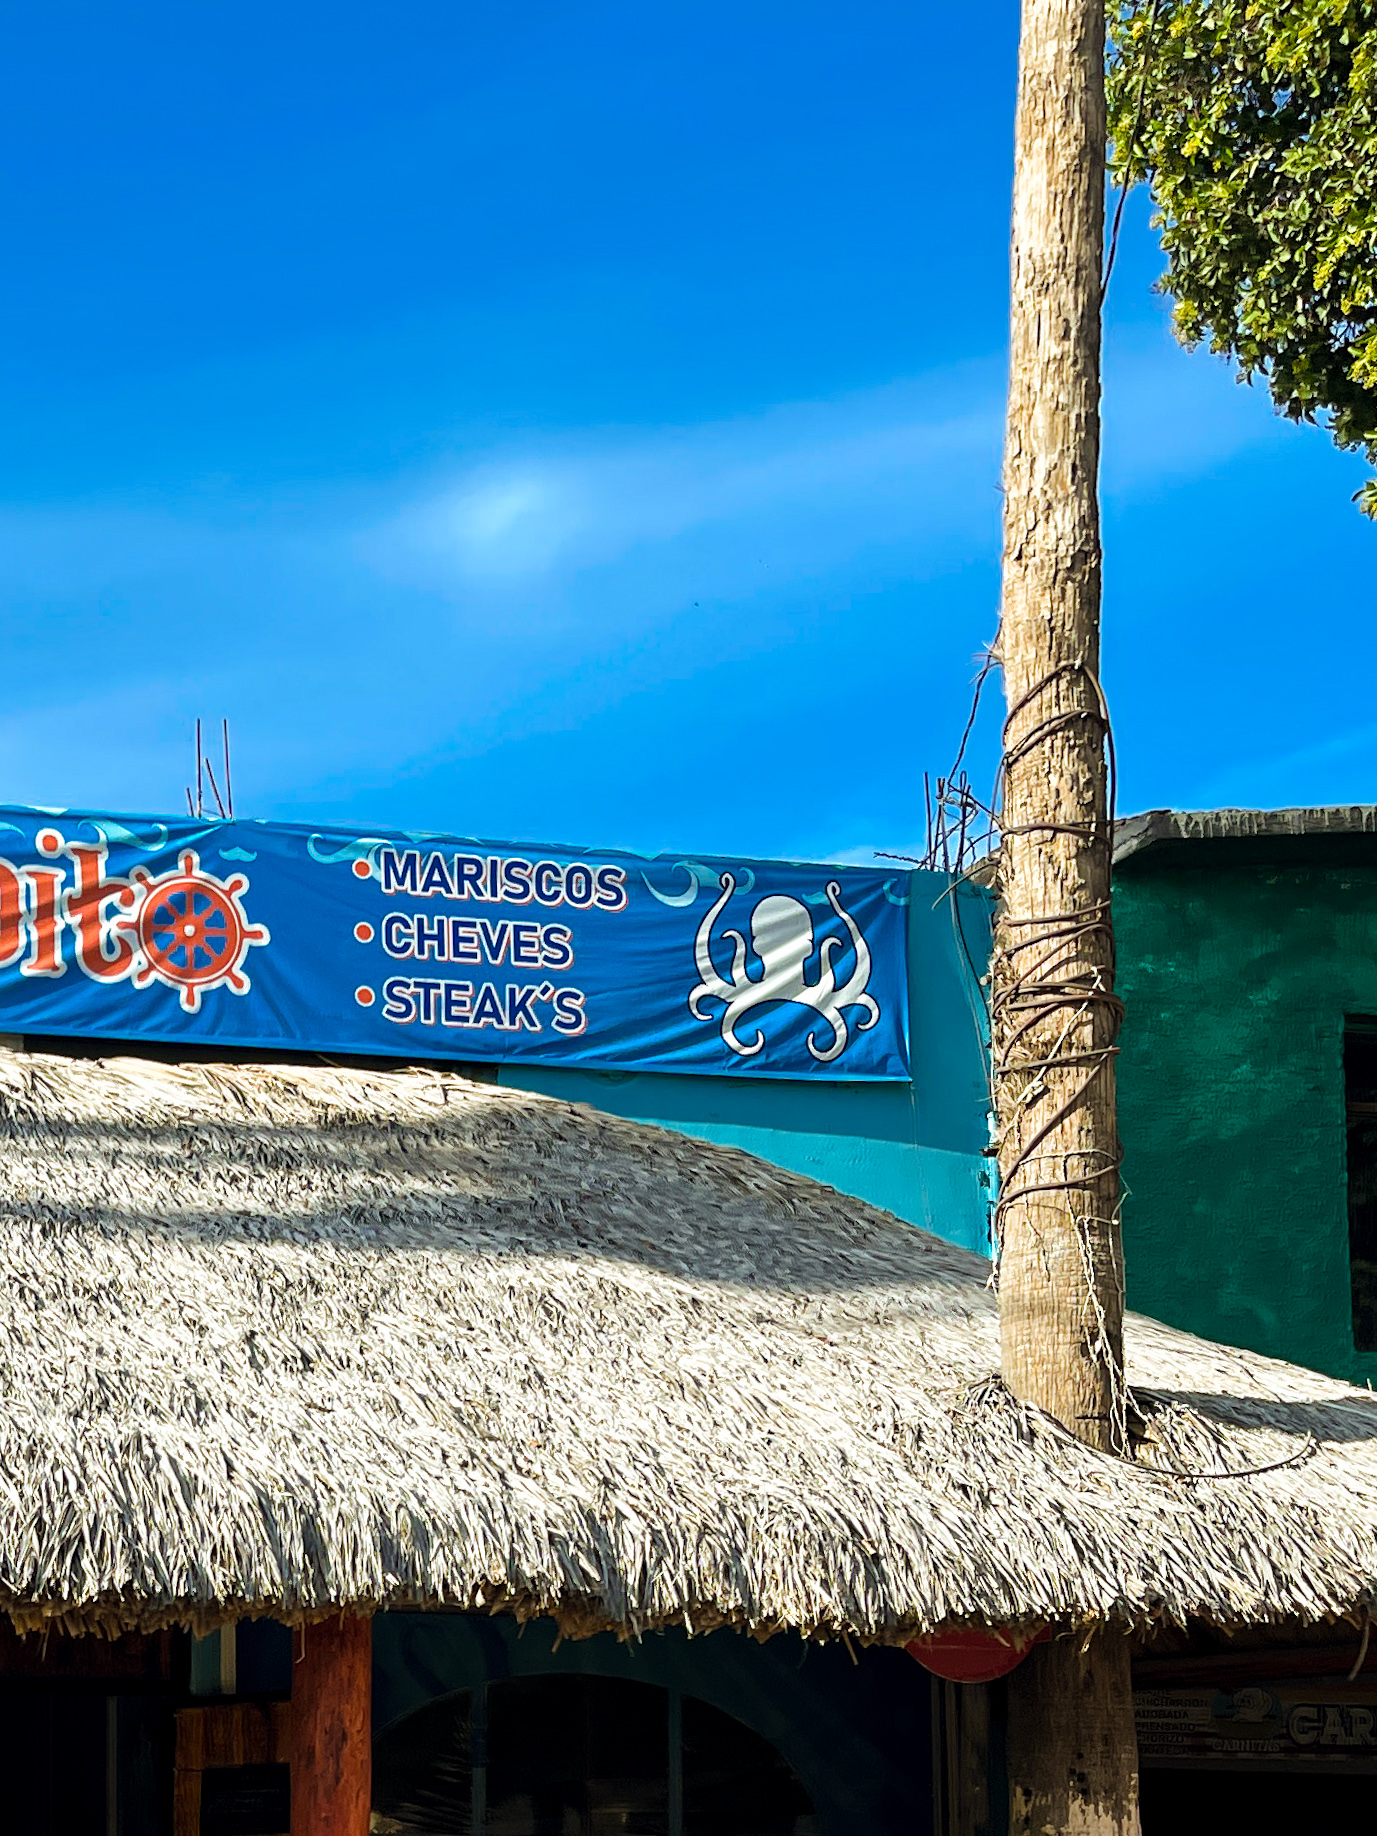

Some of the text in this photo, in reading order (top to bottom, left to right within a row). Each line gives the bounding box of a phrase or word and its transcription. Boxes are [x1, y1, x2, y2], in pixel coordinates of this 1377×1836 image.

[379, 850, 627, 911] MARISCOS
[382, 912, 573, 970] CHEVES
[381, 977, 586, 1035] STEAK'S
